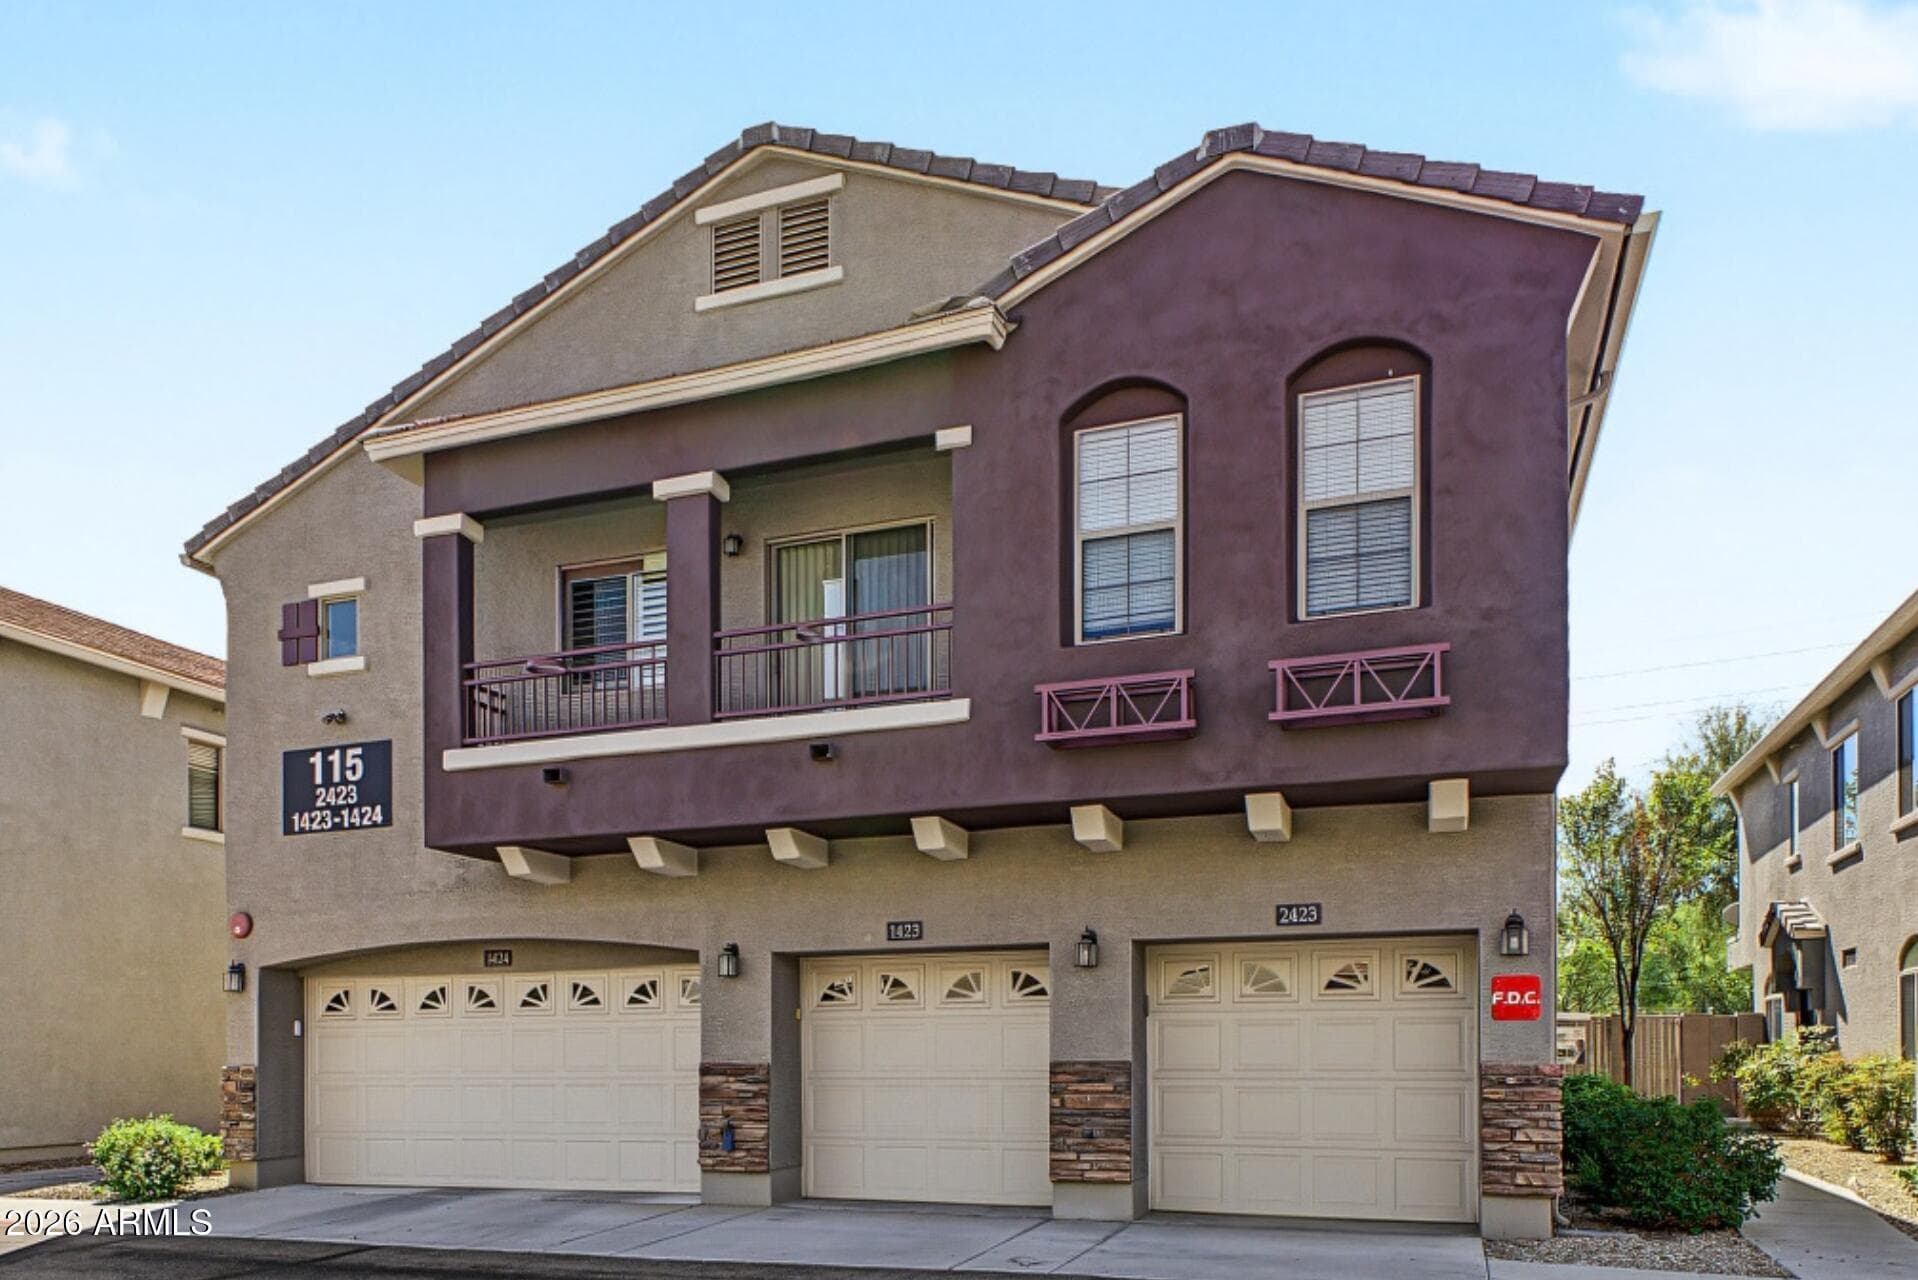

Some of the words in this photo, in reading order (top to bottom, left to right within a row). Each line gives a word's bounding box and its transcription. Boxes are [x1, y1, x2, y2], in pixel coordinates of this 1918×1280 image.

[309, 747, 364, 785] 115
[315, 785, 358, 807] 2423
[291, 804, 383, 832] 1423-1424
[1279, 905, 1318, 923] 2423
[890, 923, 920, 939] 1423
[1492, 991, 1541, 1005] F.D.C.
